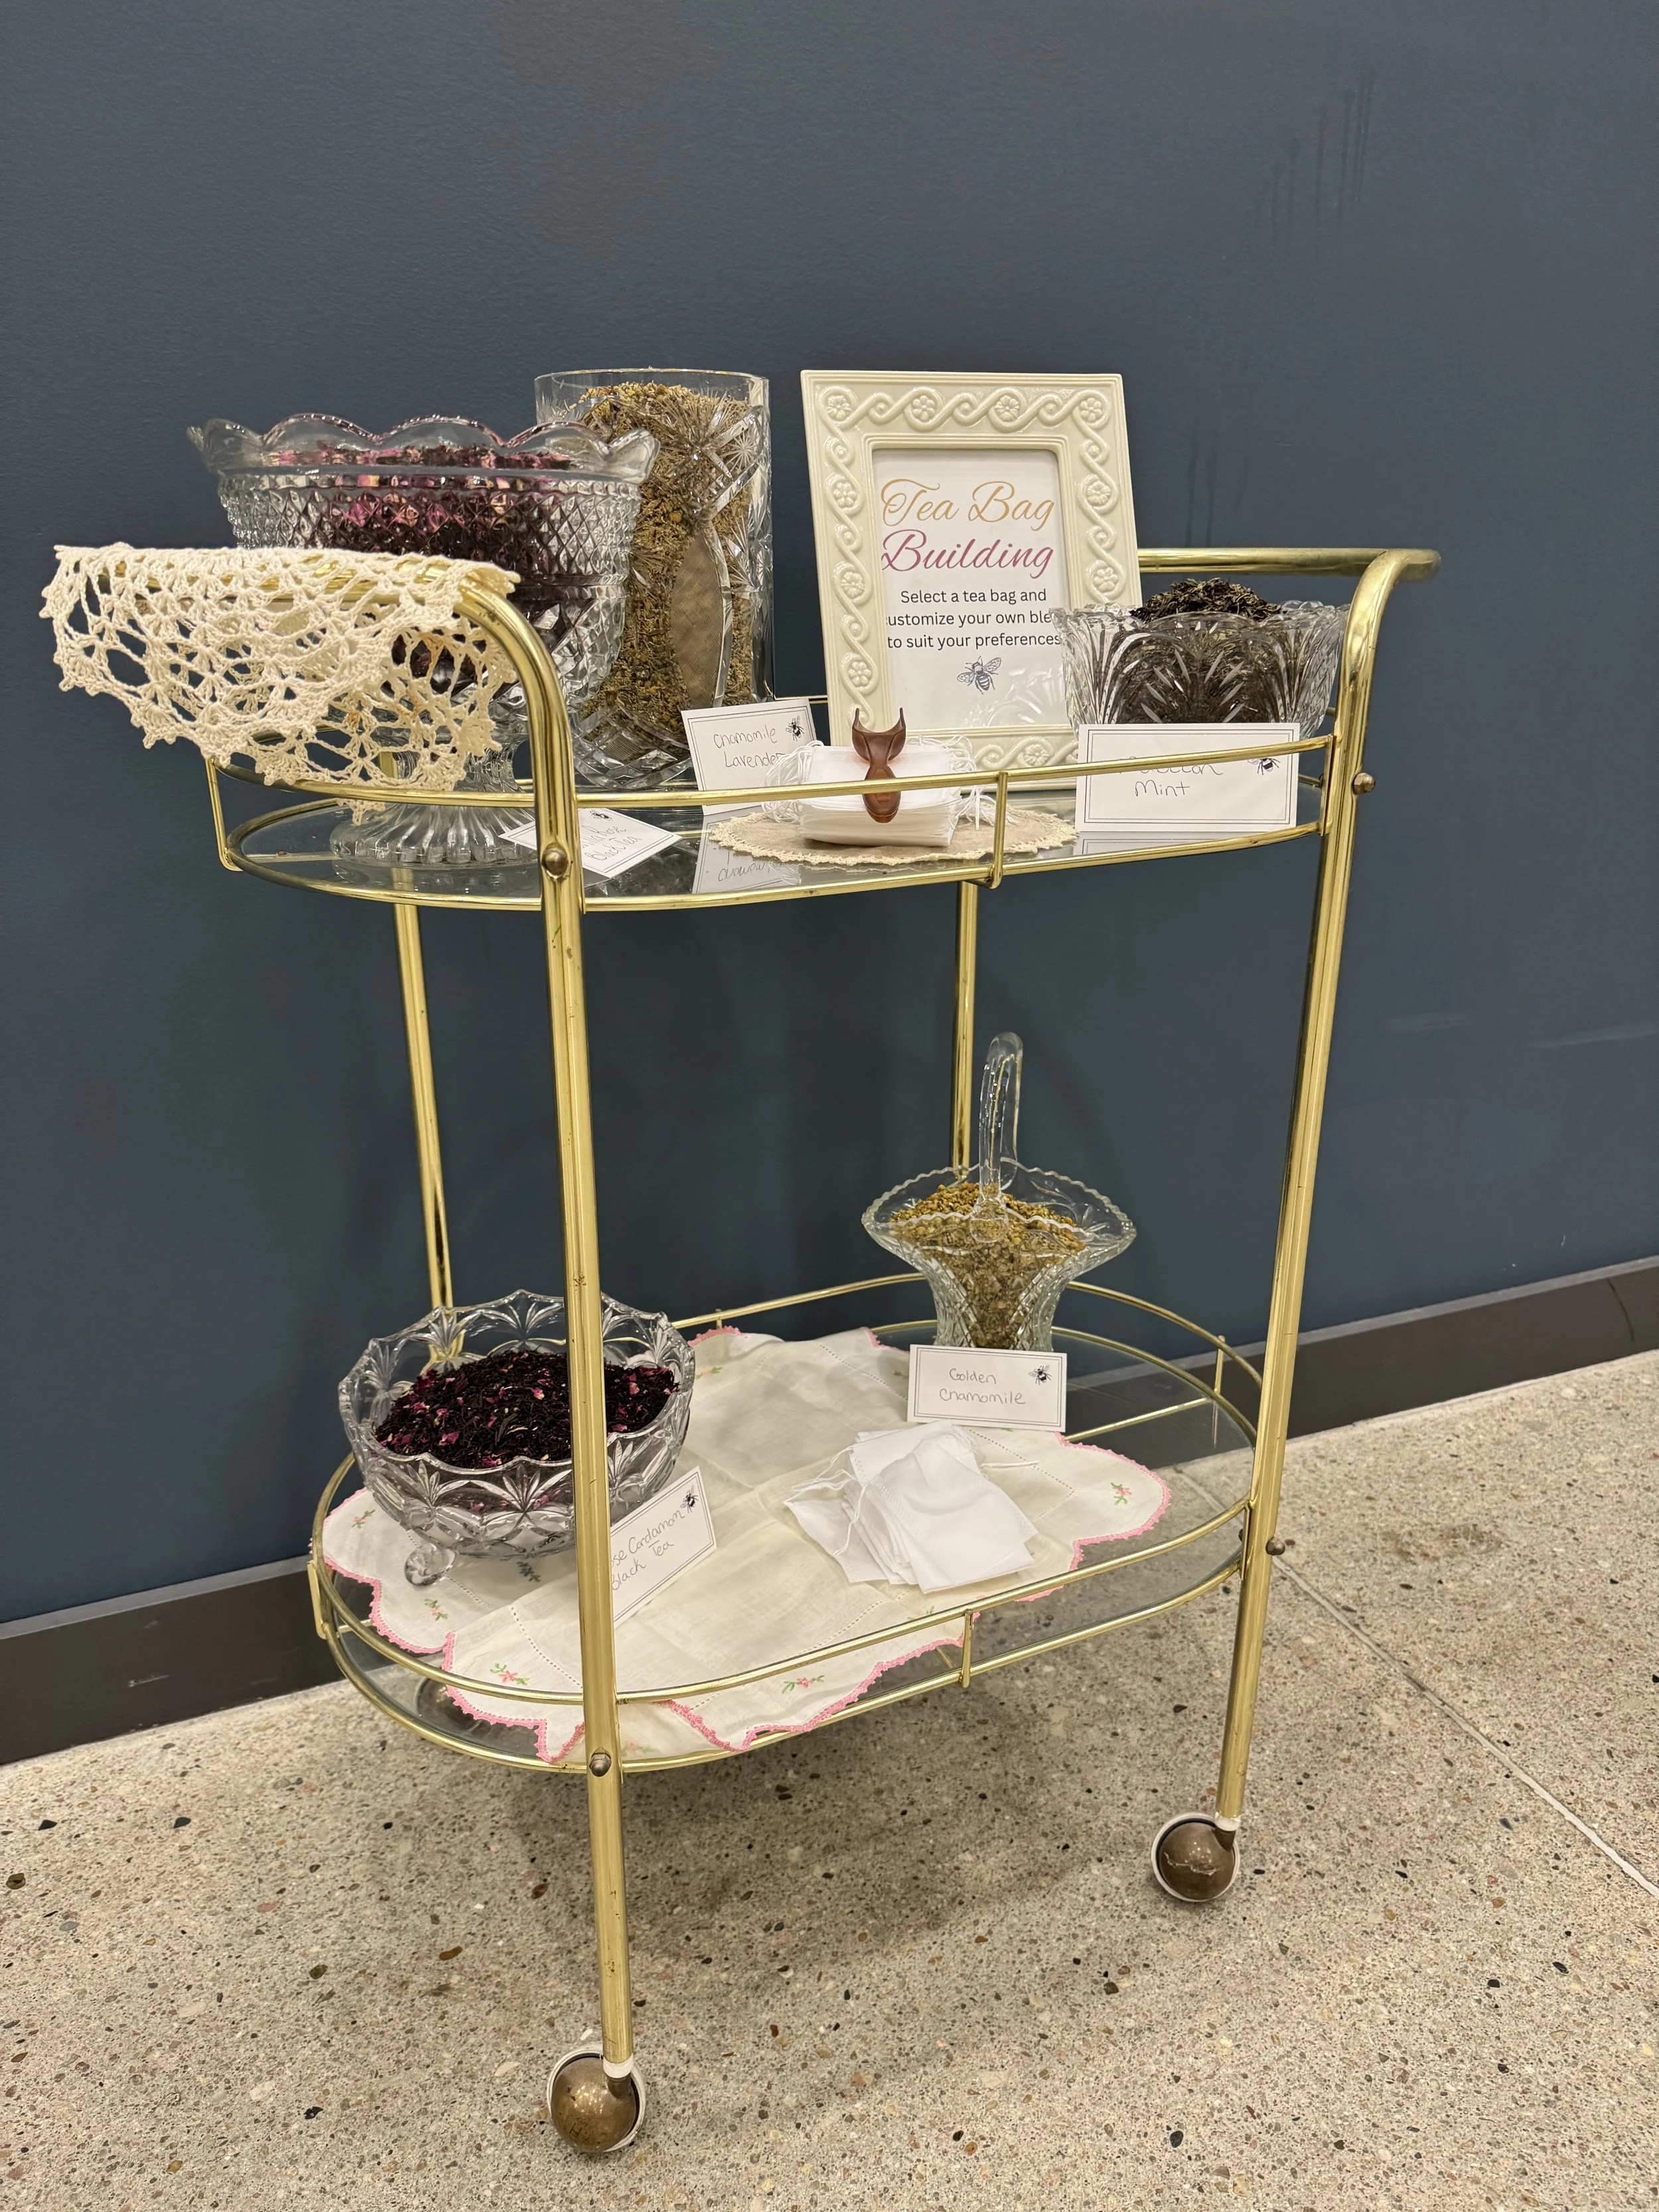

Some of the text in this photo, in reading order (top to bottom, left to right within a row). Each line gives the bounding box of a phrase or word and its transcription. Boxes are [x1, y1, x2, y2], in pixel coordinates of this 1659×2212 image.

[881, 479, 1054, 531] Tea Bag
[881, 529, 1054, 579] Building
[901, 589, 1046, 605] Select a tea bag and
[887, 613, 954, 627] ustomize
[958, 613, 991, 628] your
[995, 611, 1025, 625] own
[888, 637, 902, 648] to
[906, 634, 934, 648] suit
[938, 635, 971, 651] your
[1135, 779, 1190, 797] Mint
[584, 836, 642, 861] Black Tea
[950, 1368, 997, 1384] Golden
[940, 1388, 1025, 1404] Chamomile
[648, 1540, 674, 1556] Tea
